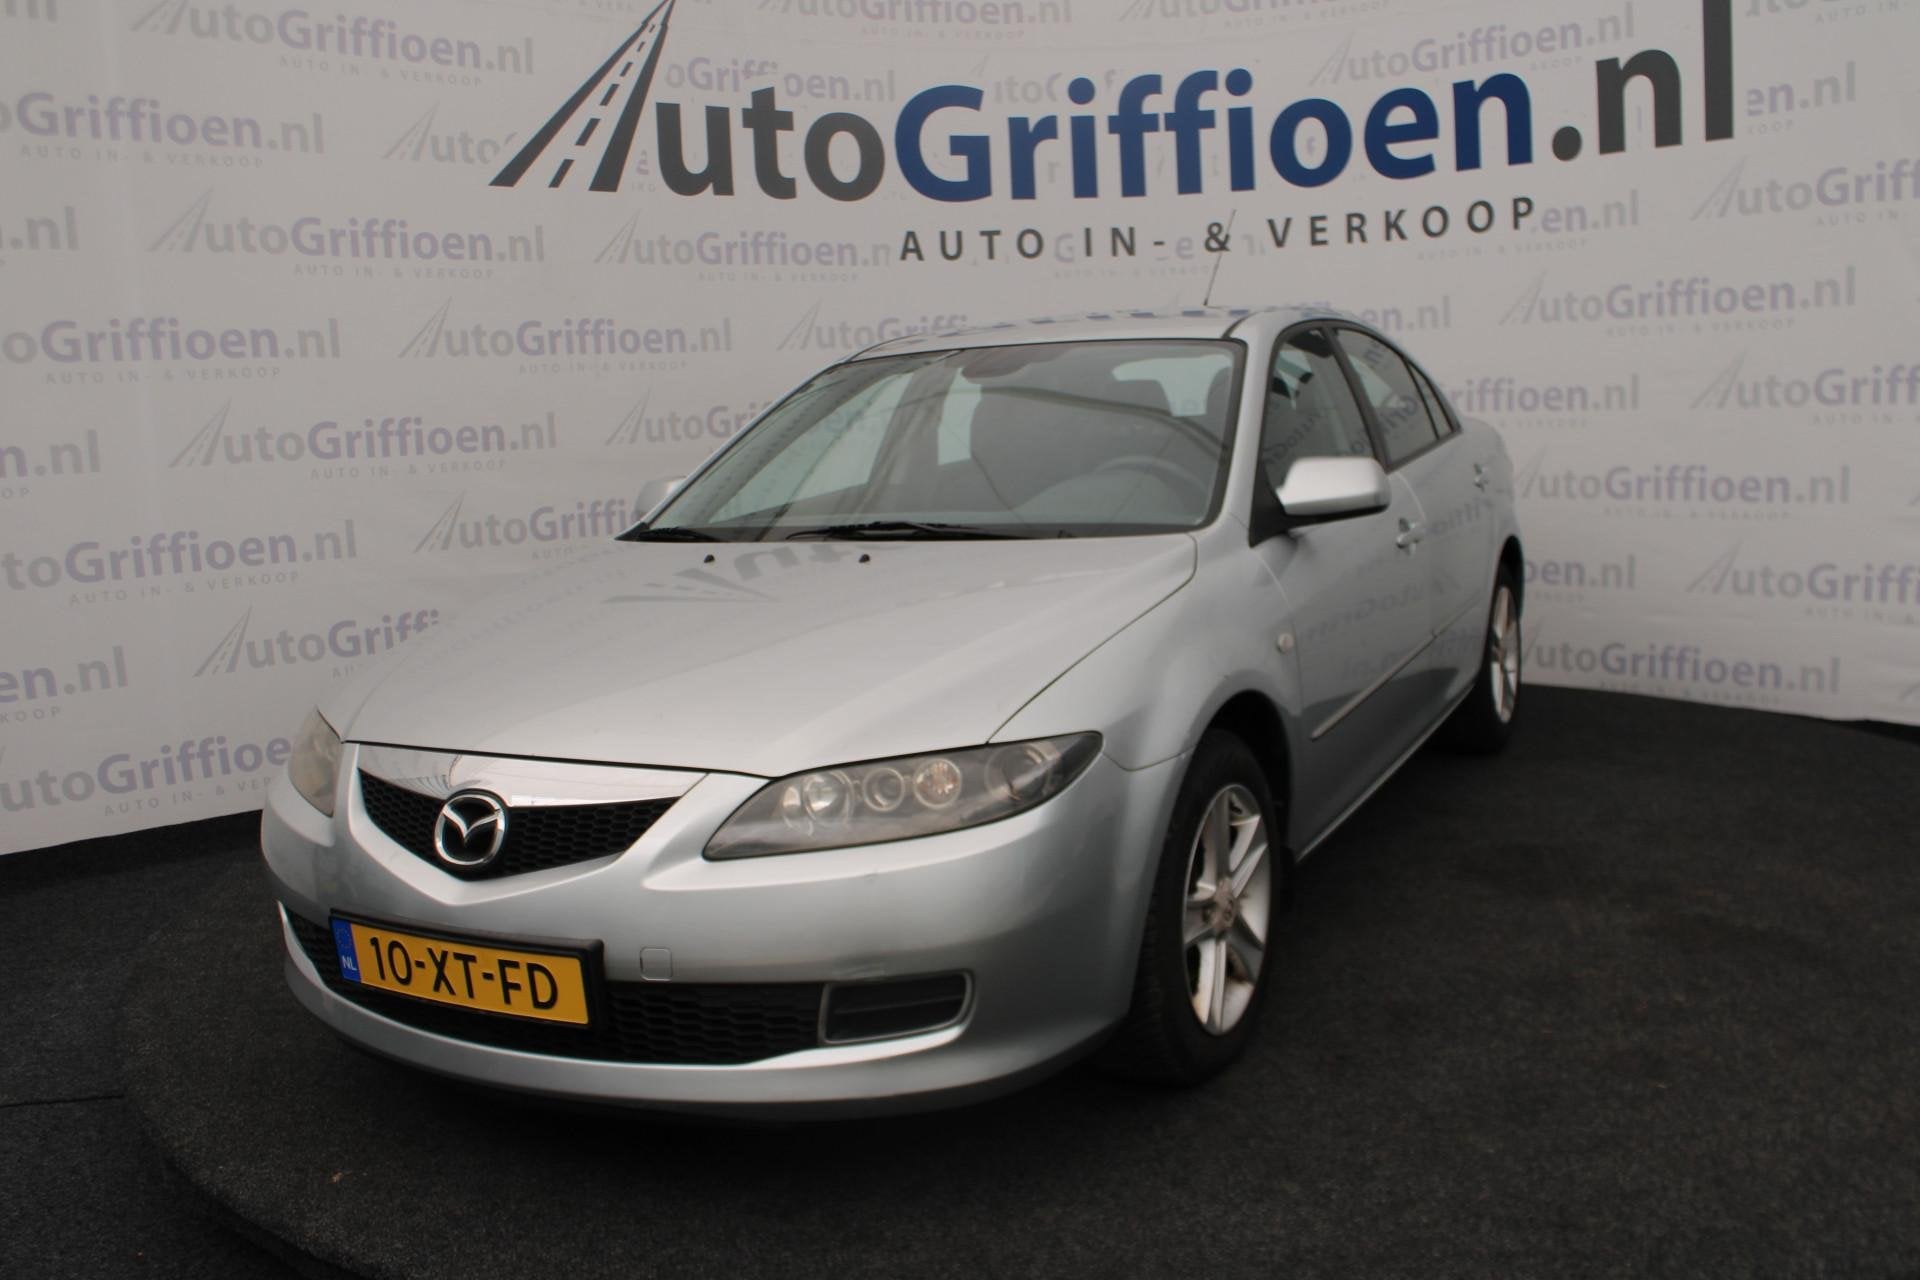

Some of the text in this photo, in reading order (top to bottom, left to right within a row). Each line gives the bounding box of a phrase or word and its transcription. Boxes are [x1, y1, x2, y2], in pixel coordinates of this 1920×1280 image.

[1308, 1, 1635, 86] AutoGriffioen.nl
[400, 69, 482, 87] VERKOOP
[488, 0, 1735, 203] AutoGriffioen.nl
[167, 153, 264, 168] VERKOOP
[146, 186, 546, 262] AutoGriffioen.nl
[593, 208, 892, 266] AutoGriffioen.n
[900, 229, 1046, 261] AUTO
[1203, 221, 1232, 253] &
[1266, 195, 1536, 249] VERKOOP
[414, 266, 495, 280] VERKOOP
[1498, 264, 1857, 326] AutoGriffioen.nl
[397, 295, 733, 358] AutoGriffioen.nl
[186, 365, 282, 382] VERKOOP
[167, 397, 557, 469] AutoGriffioen.nl
[69, 588, 129, 606] AUTO
[206, 570, 301, 593] VERKOOP
[342, 954, 357, 971] NL
[370, 936, 558, 1010] 10-XT-FD
